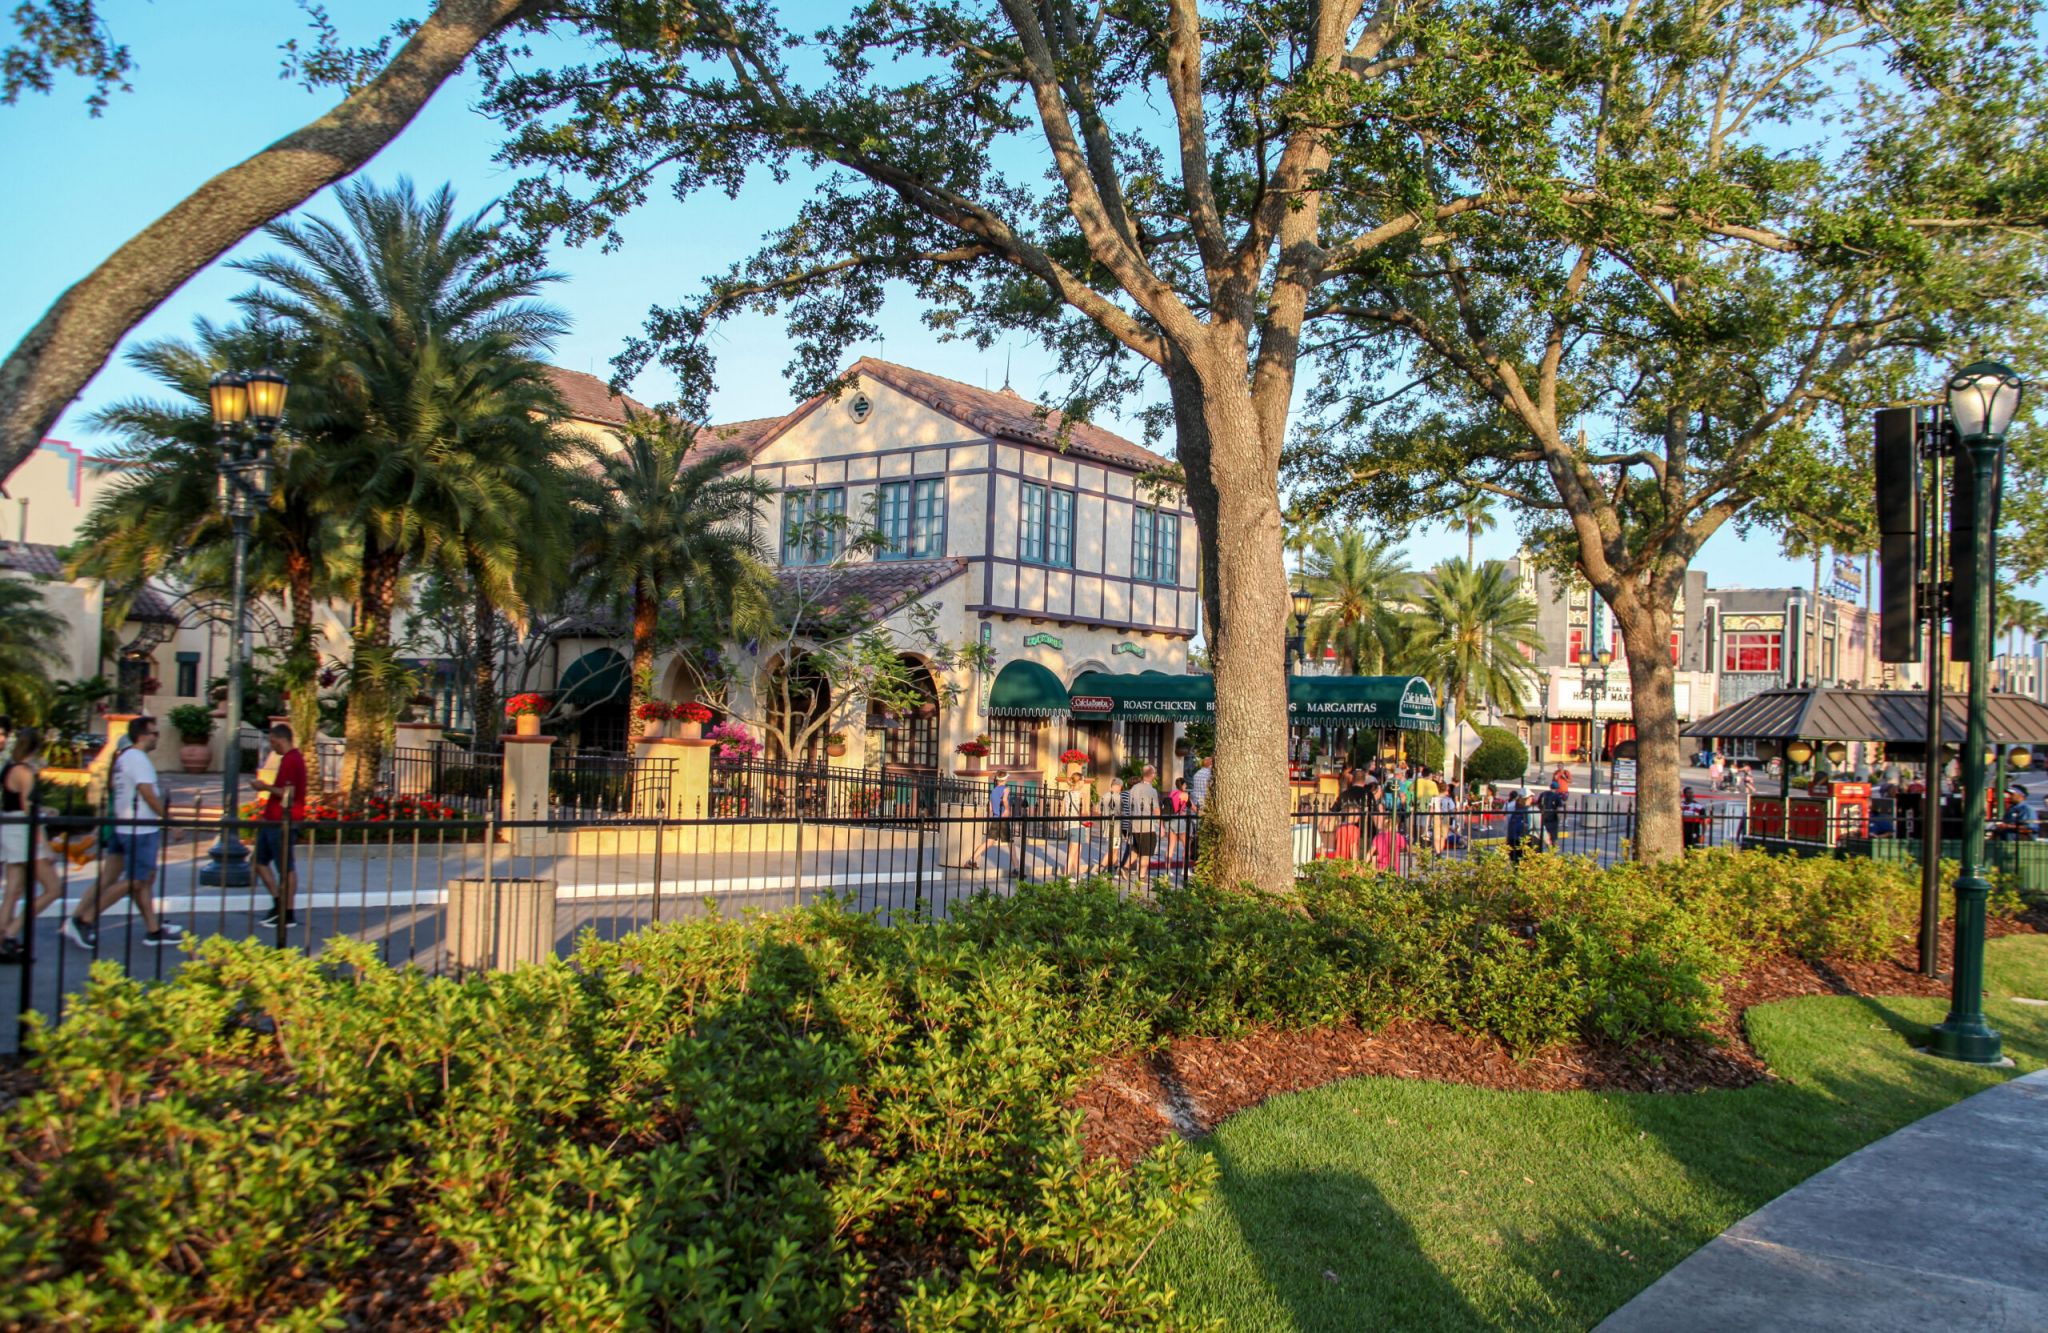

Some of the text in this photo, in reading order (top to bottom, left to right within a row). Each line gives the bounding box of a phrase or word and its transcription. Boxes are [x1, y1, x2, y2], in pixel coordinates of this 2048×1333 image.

[1124, 701, 1153, 710] ROAST
[1154, 701, 1196, 711] CHICKEN
[1307, 703, 1377, 713] MARGARITAS
